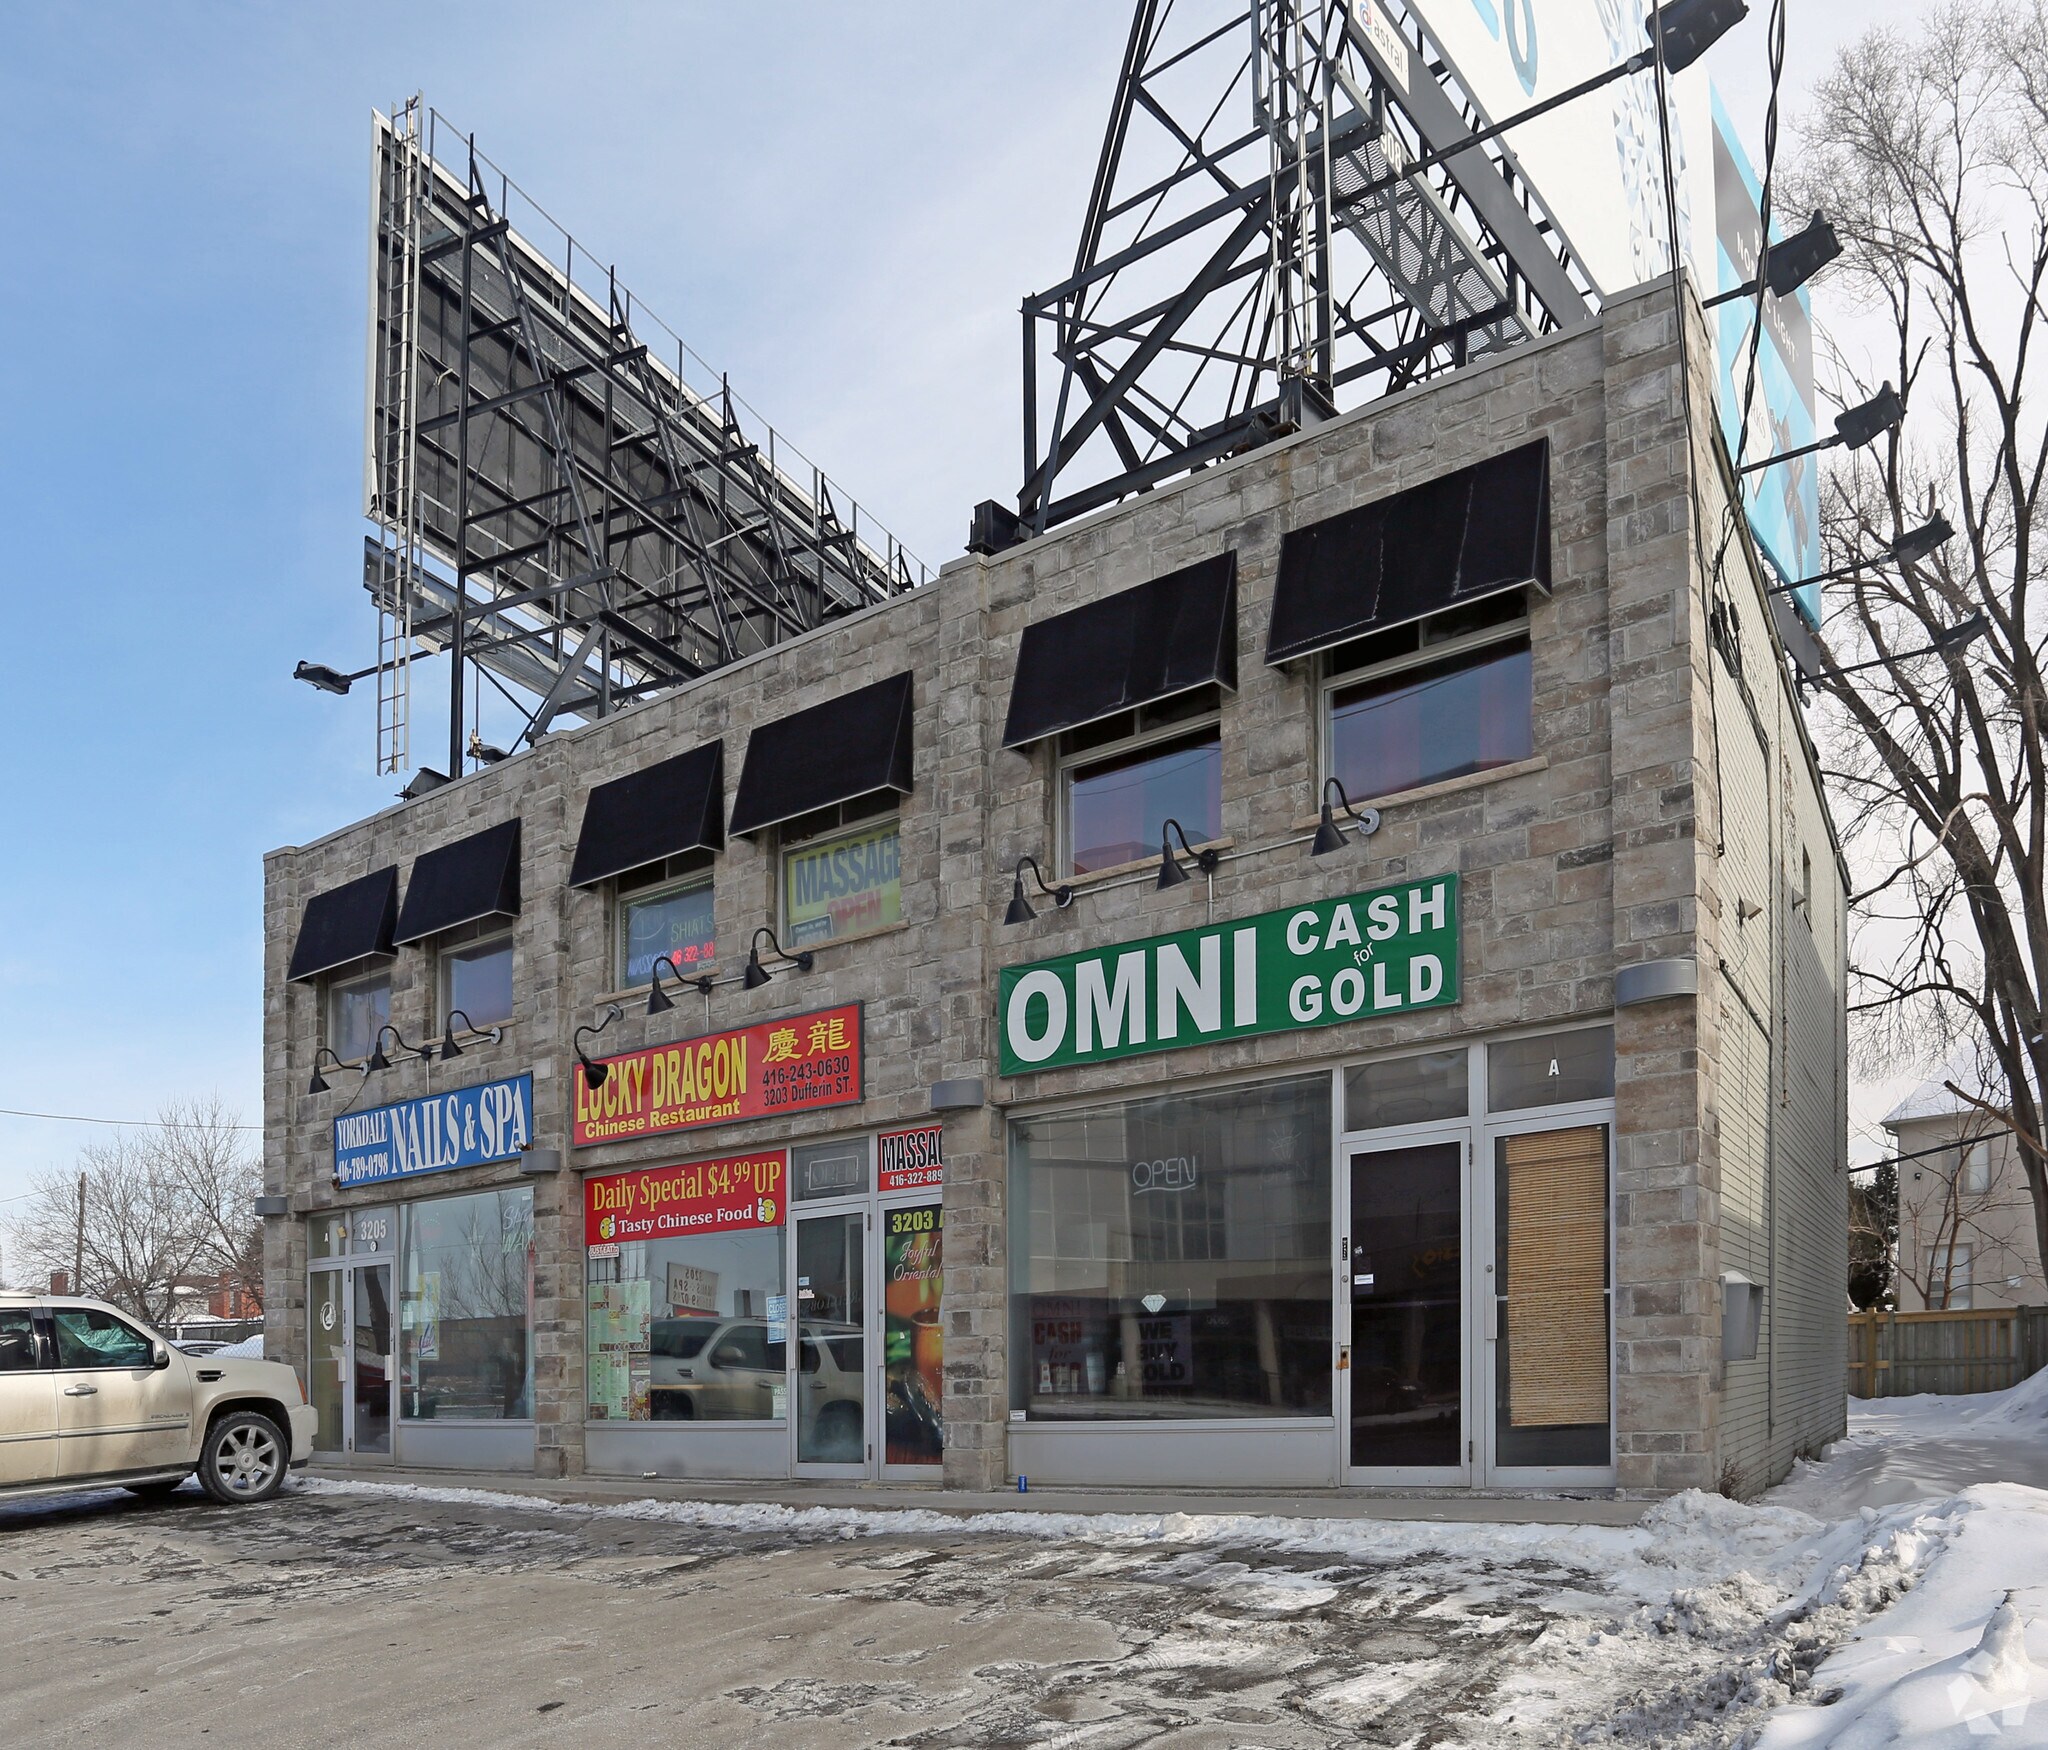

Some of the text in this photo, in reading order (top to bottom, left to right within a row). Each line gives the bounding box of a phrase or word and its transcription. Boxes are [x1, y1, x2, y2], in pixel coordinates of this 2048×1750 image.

[1374, 19, 1403, 73] astral
[1773, 305, 1795, 362] LIGHT
[1286, 883, 1446, 955] CASH
[1353, 943, 1374, 967] for
[1006, 927, 1257, 1063] OMNI
[1288, 953, 1443, 1023] GOLD
[653, 1035, 747, 1109] DRAGON
[762, 1055, 850, 1087] 416-243-0630
[1548, 1058, 1560, 1076] A
[763, 1075, 854, 1107] 3203 Dufferin ST.
[336, 1110, 388, 1151] YORKDALE
[389, 1080, 527, 1175] NAILS & SPA
[585, 1098, 740, 1139] Chinese Restaurant
[337, 1152, 389, 1182] 416-789-0798
[1132, 1155, 1196, 1187] OPEN
[593, 1160, 781, 1215] Daily Special $4.99 UP
[361, 1219, 387, 1240] 3205
[619, 1204, 753, 1235] Tasty Chinese Food
[892, 1210, 934, 1233] 3203
[900, 1239, 940, 1266] Joyful
[893, 1260, 944, 1282] Oriental
